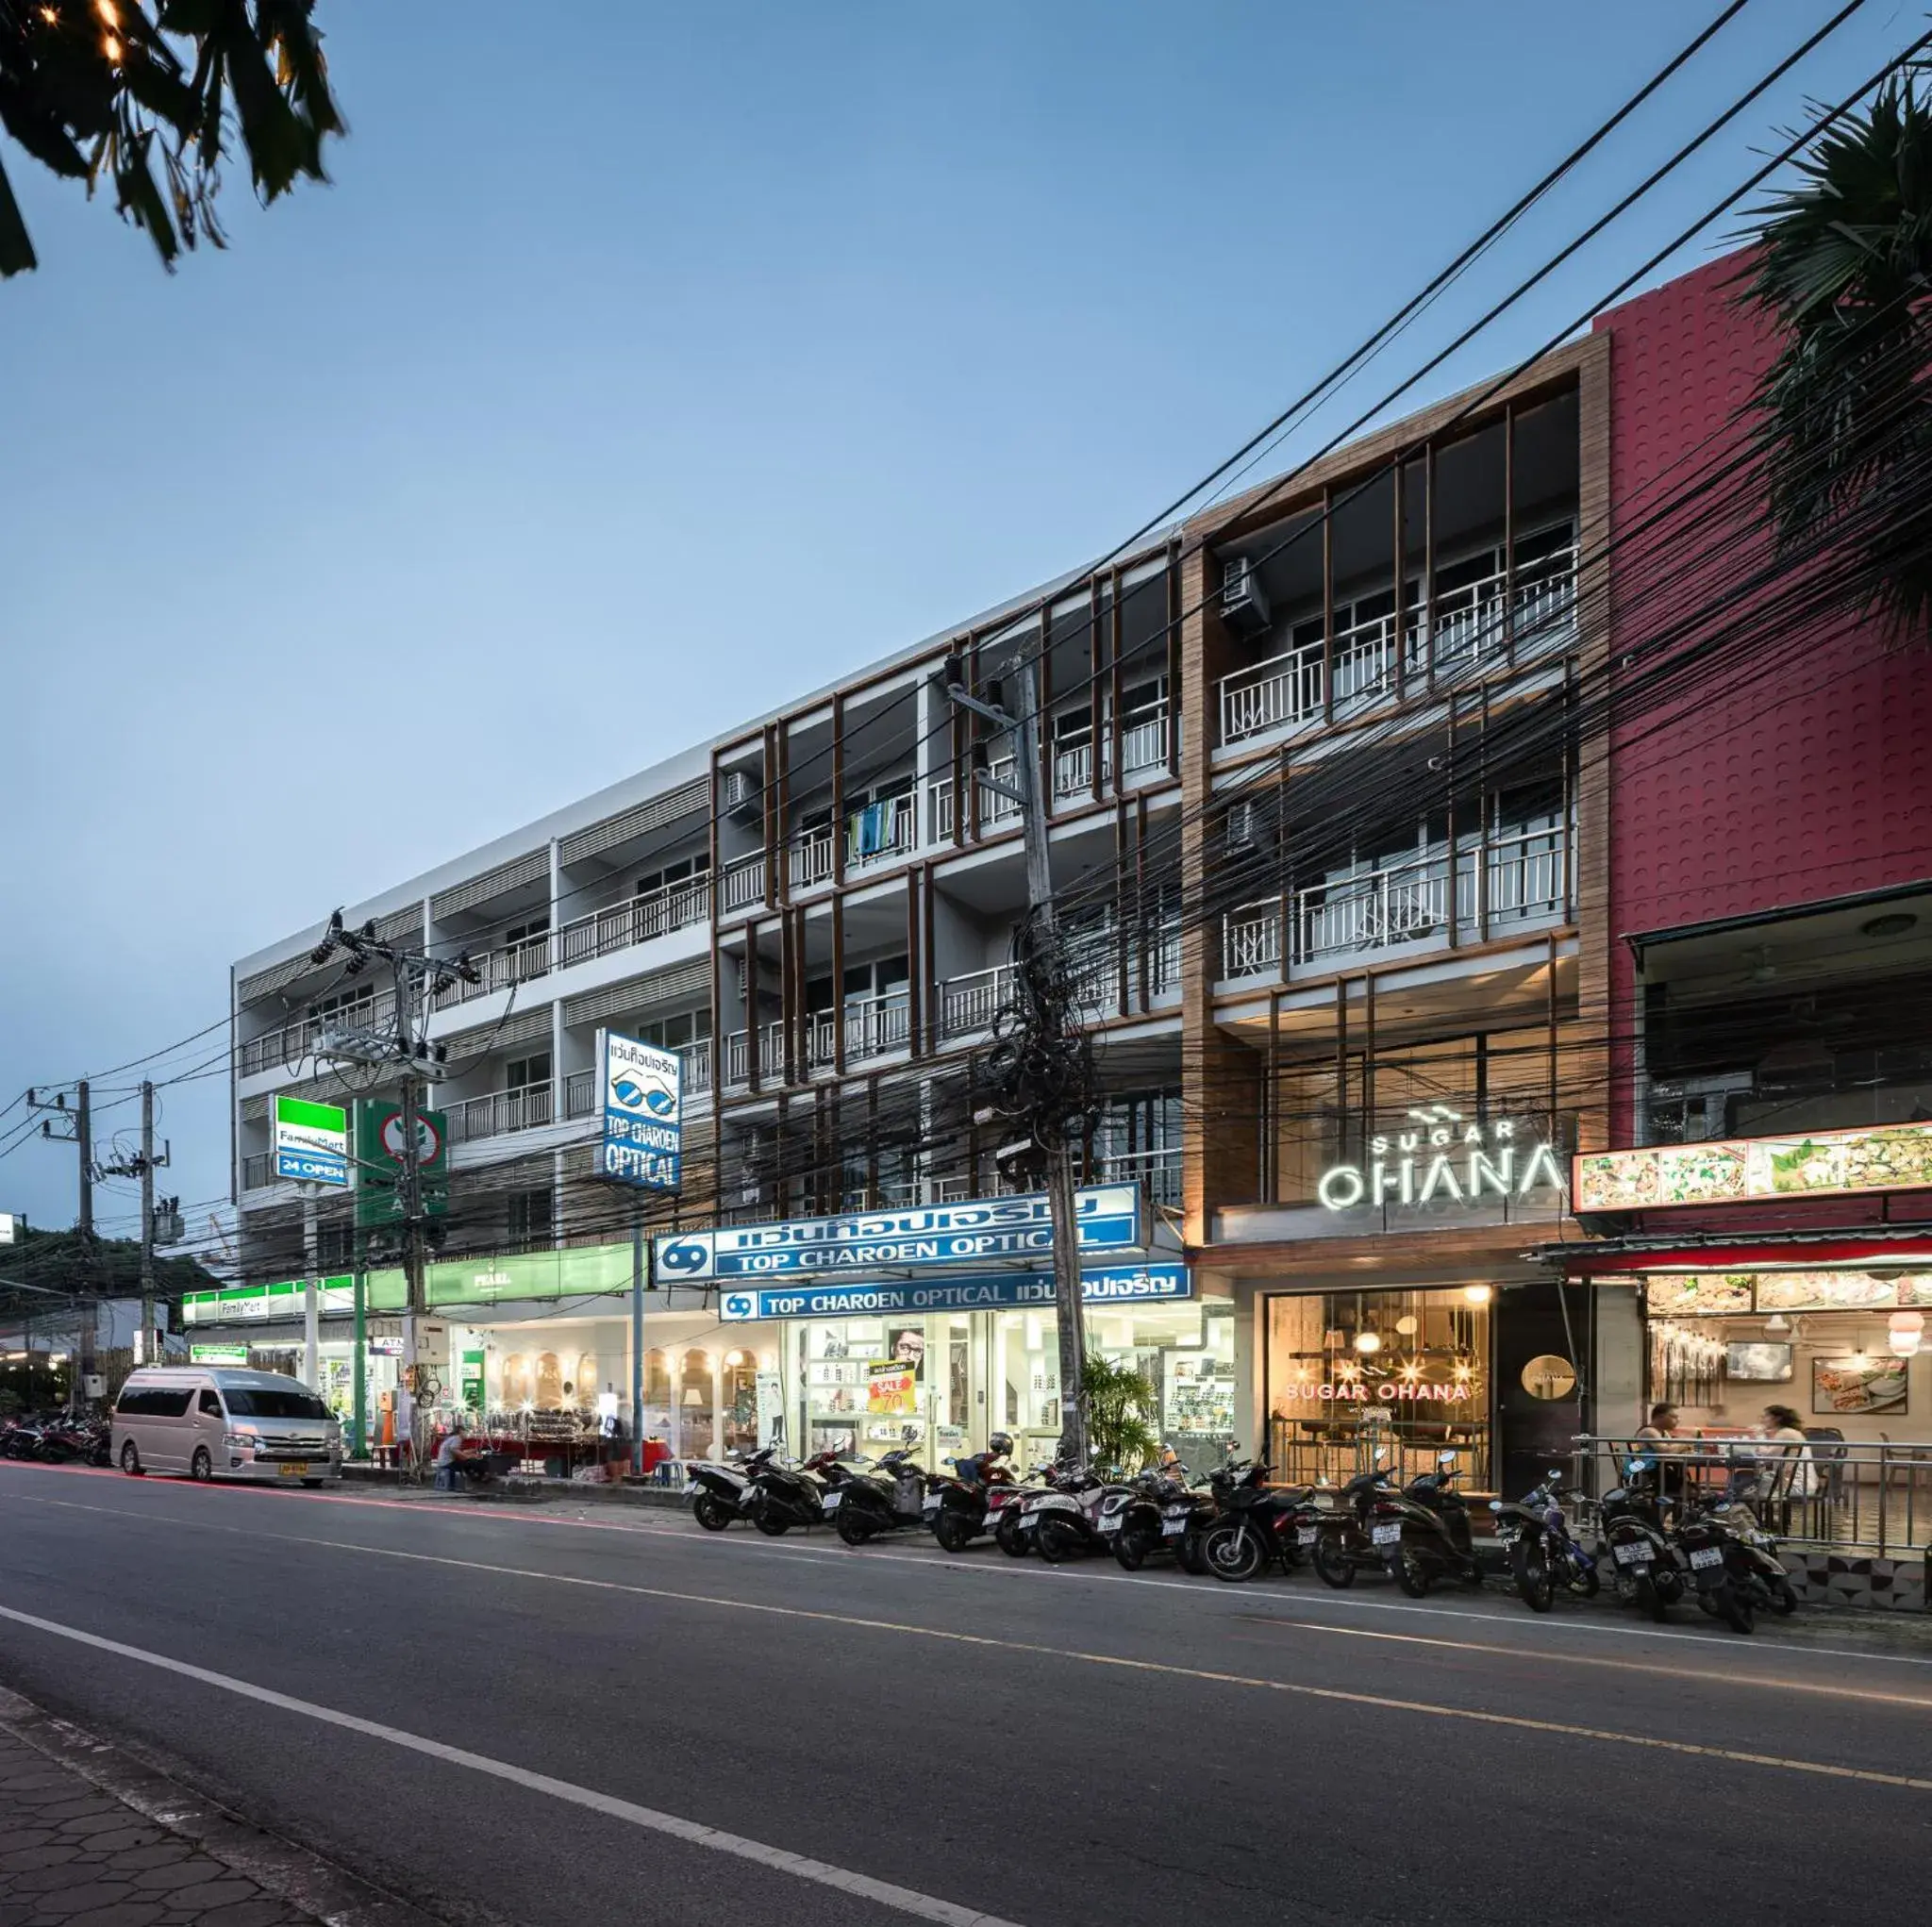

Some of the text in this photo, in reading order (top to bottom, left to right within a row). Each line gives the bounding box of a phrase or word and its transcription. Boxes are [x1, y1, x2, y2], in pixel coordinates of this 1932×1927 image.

[610, 1043, 678, 1076] แว่นท็อปเจริญ
[280, 1131, 344, 1150] FamilyMart
[608, 1115, 679, 1154] TOP CHAROEN
[1372, 1121, 1514, 1155] SUGAR
[283, 1159, 344, 1178] 24 OPEN
[606, 1143, 675, 1186] OPTICAL
[1318, 1144, 1564, 1210] OHANA
[739, 1227, 1099, 1271] TOP CHAROEN OPTICL
[223, 1302, 260, 1315] FamilyMart
[768, 1285, 1007, 1314] TOP CHAROEN OPTICAL
[877, 1378, 904, 1393] SALE
[1286, 1384, 1469, 1401] SUGAR OHANA
